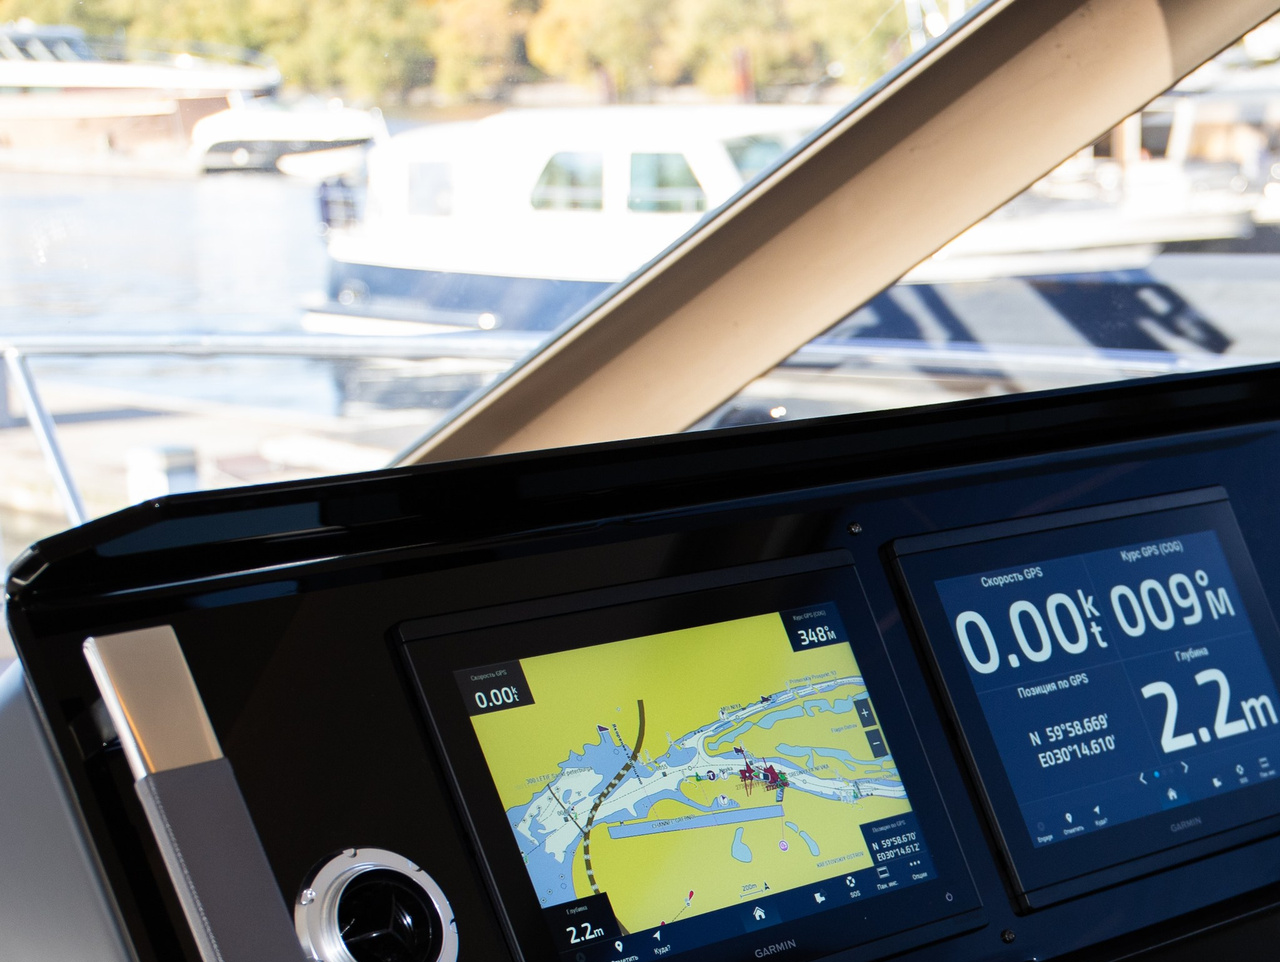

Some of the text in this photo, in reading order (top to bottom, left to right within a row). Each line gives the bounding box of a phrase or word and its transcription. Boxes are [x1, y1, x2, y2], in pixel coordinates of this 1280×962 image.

[1120, 540, 1184, 563] Курс GPS (COG)
[980, 566, 1043, 589] Скорость GPS
[804, 611, 814, 619] GPS
[955, 592, 1089, 675] 0.00
[1174, 645, 1210, 663] Глубина
[470, 669, 507, 682] Скорость GPS
[1017, 672, 1089, 699] Позиция по GPS
[474, 686, 514, 709] 0.00
[1141, 667, 1279, 755] 2.2m
[1029, 730, 1042, 747] N
[1170, 816, 1202, 833] GARMIN
[872, 842, 880, 851] N
[741, 883, 758, 892] 200m
[849, 890, 861, 898] SOS
[565, 904, 588, 915] Глубина
[566, 921, 605, 945] 2.2m
[653, 944, 671, 955] Куда?
[754, 939, 797, 959] GARMIN
